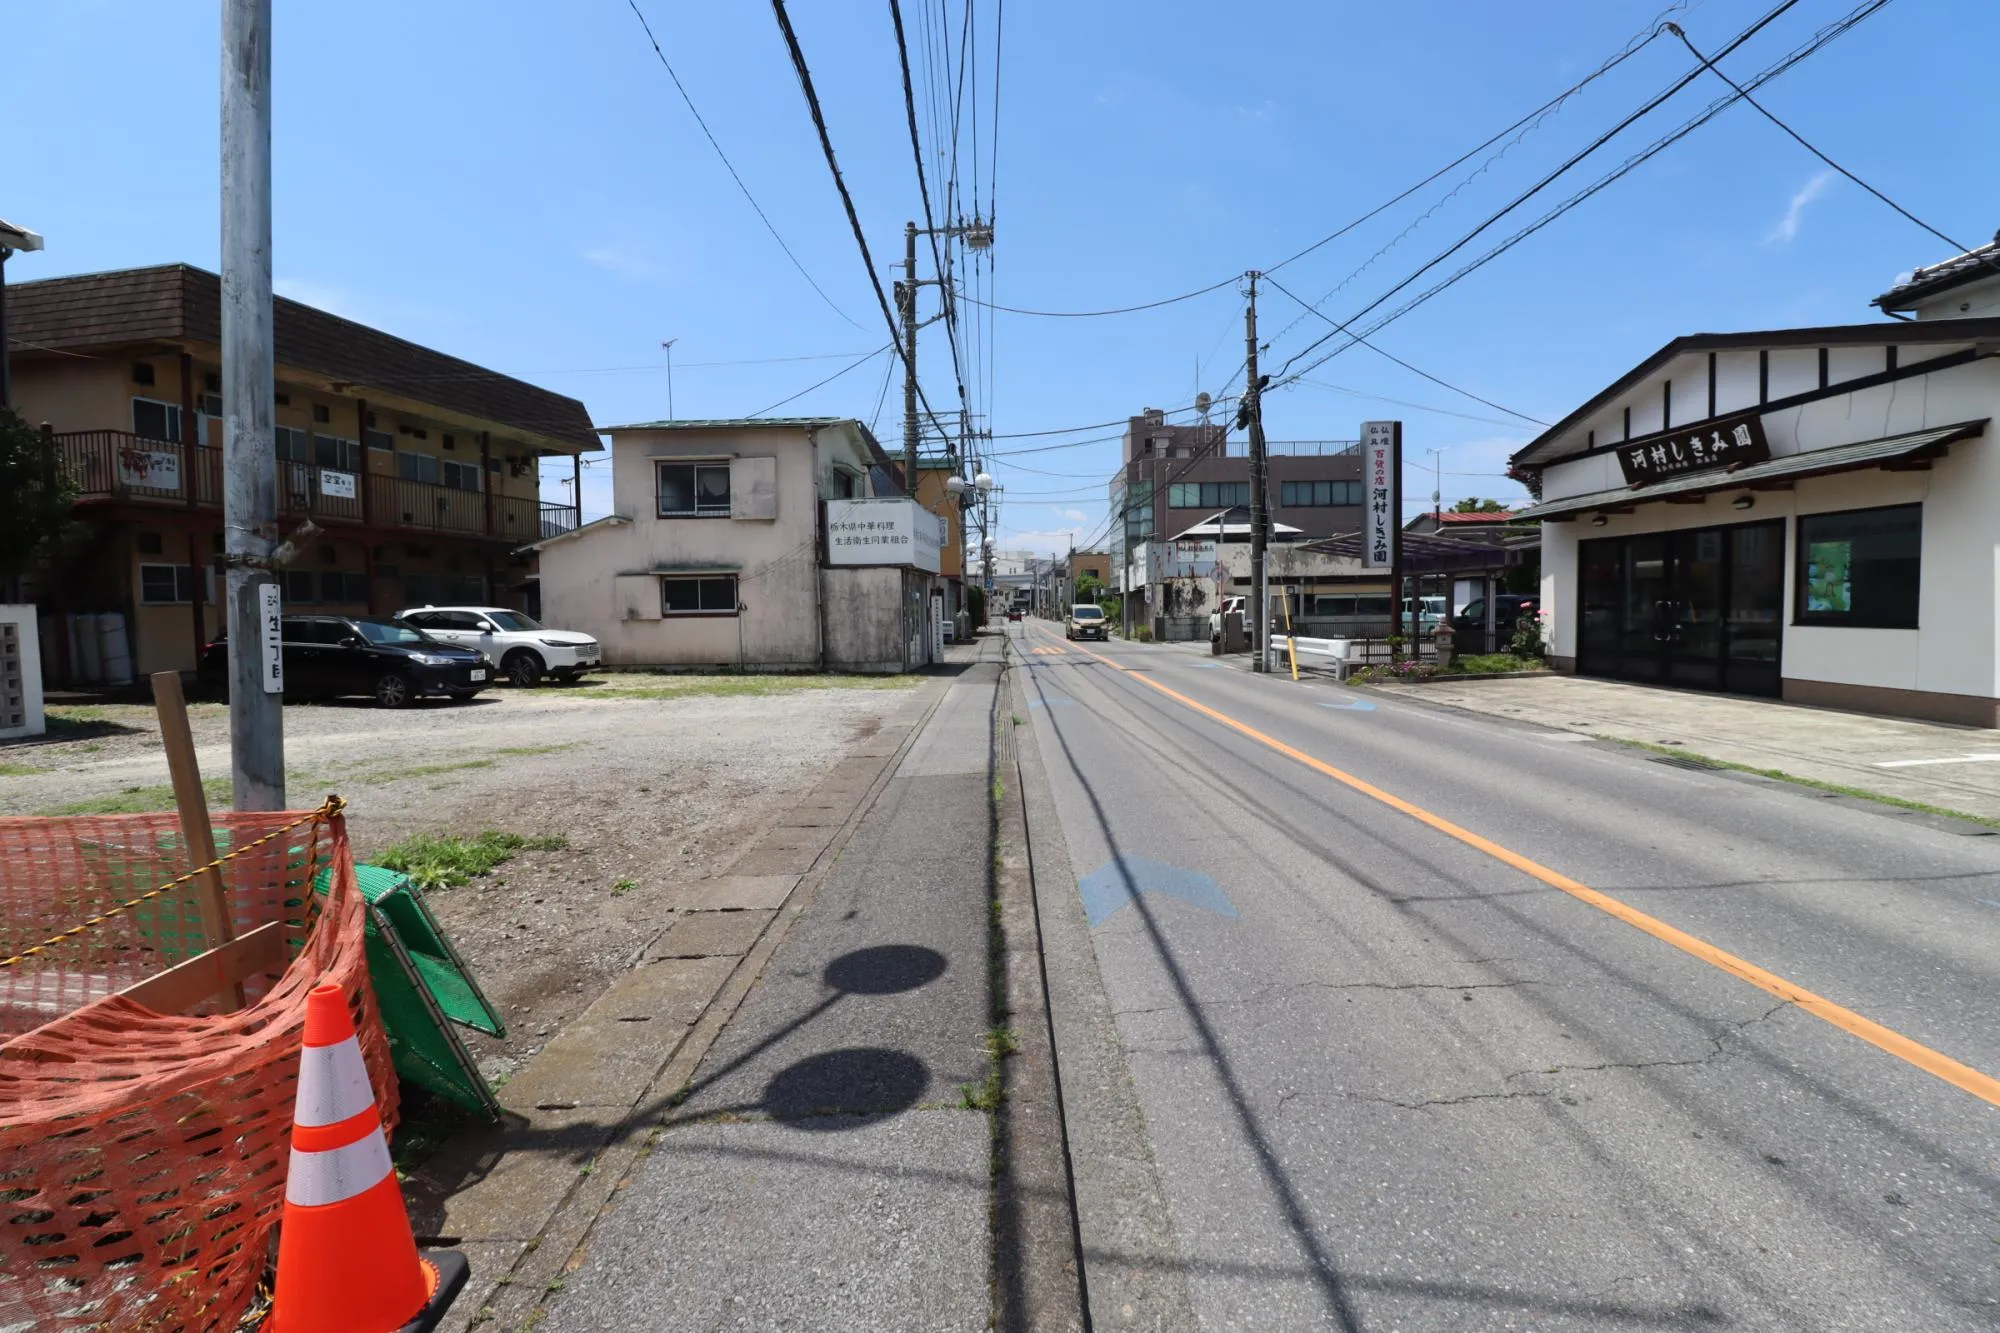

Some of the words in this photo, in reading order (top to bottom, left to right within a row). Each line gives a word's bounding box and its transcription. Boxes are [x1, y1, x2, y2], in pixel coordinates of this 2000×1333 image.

[1630, 423, 1752, 469] 河村しきみ園
[1373, 449, 1386, 486] 百貨の店
[830, 521, 895, 532] 栃木県中華料理
[1372, 487, 1388, 563] 河村しきみ園
